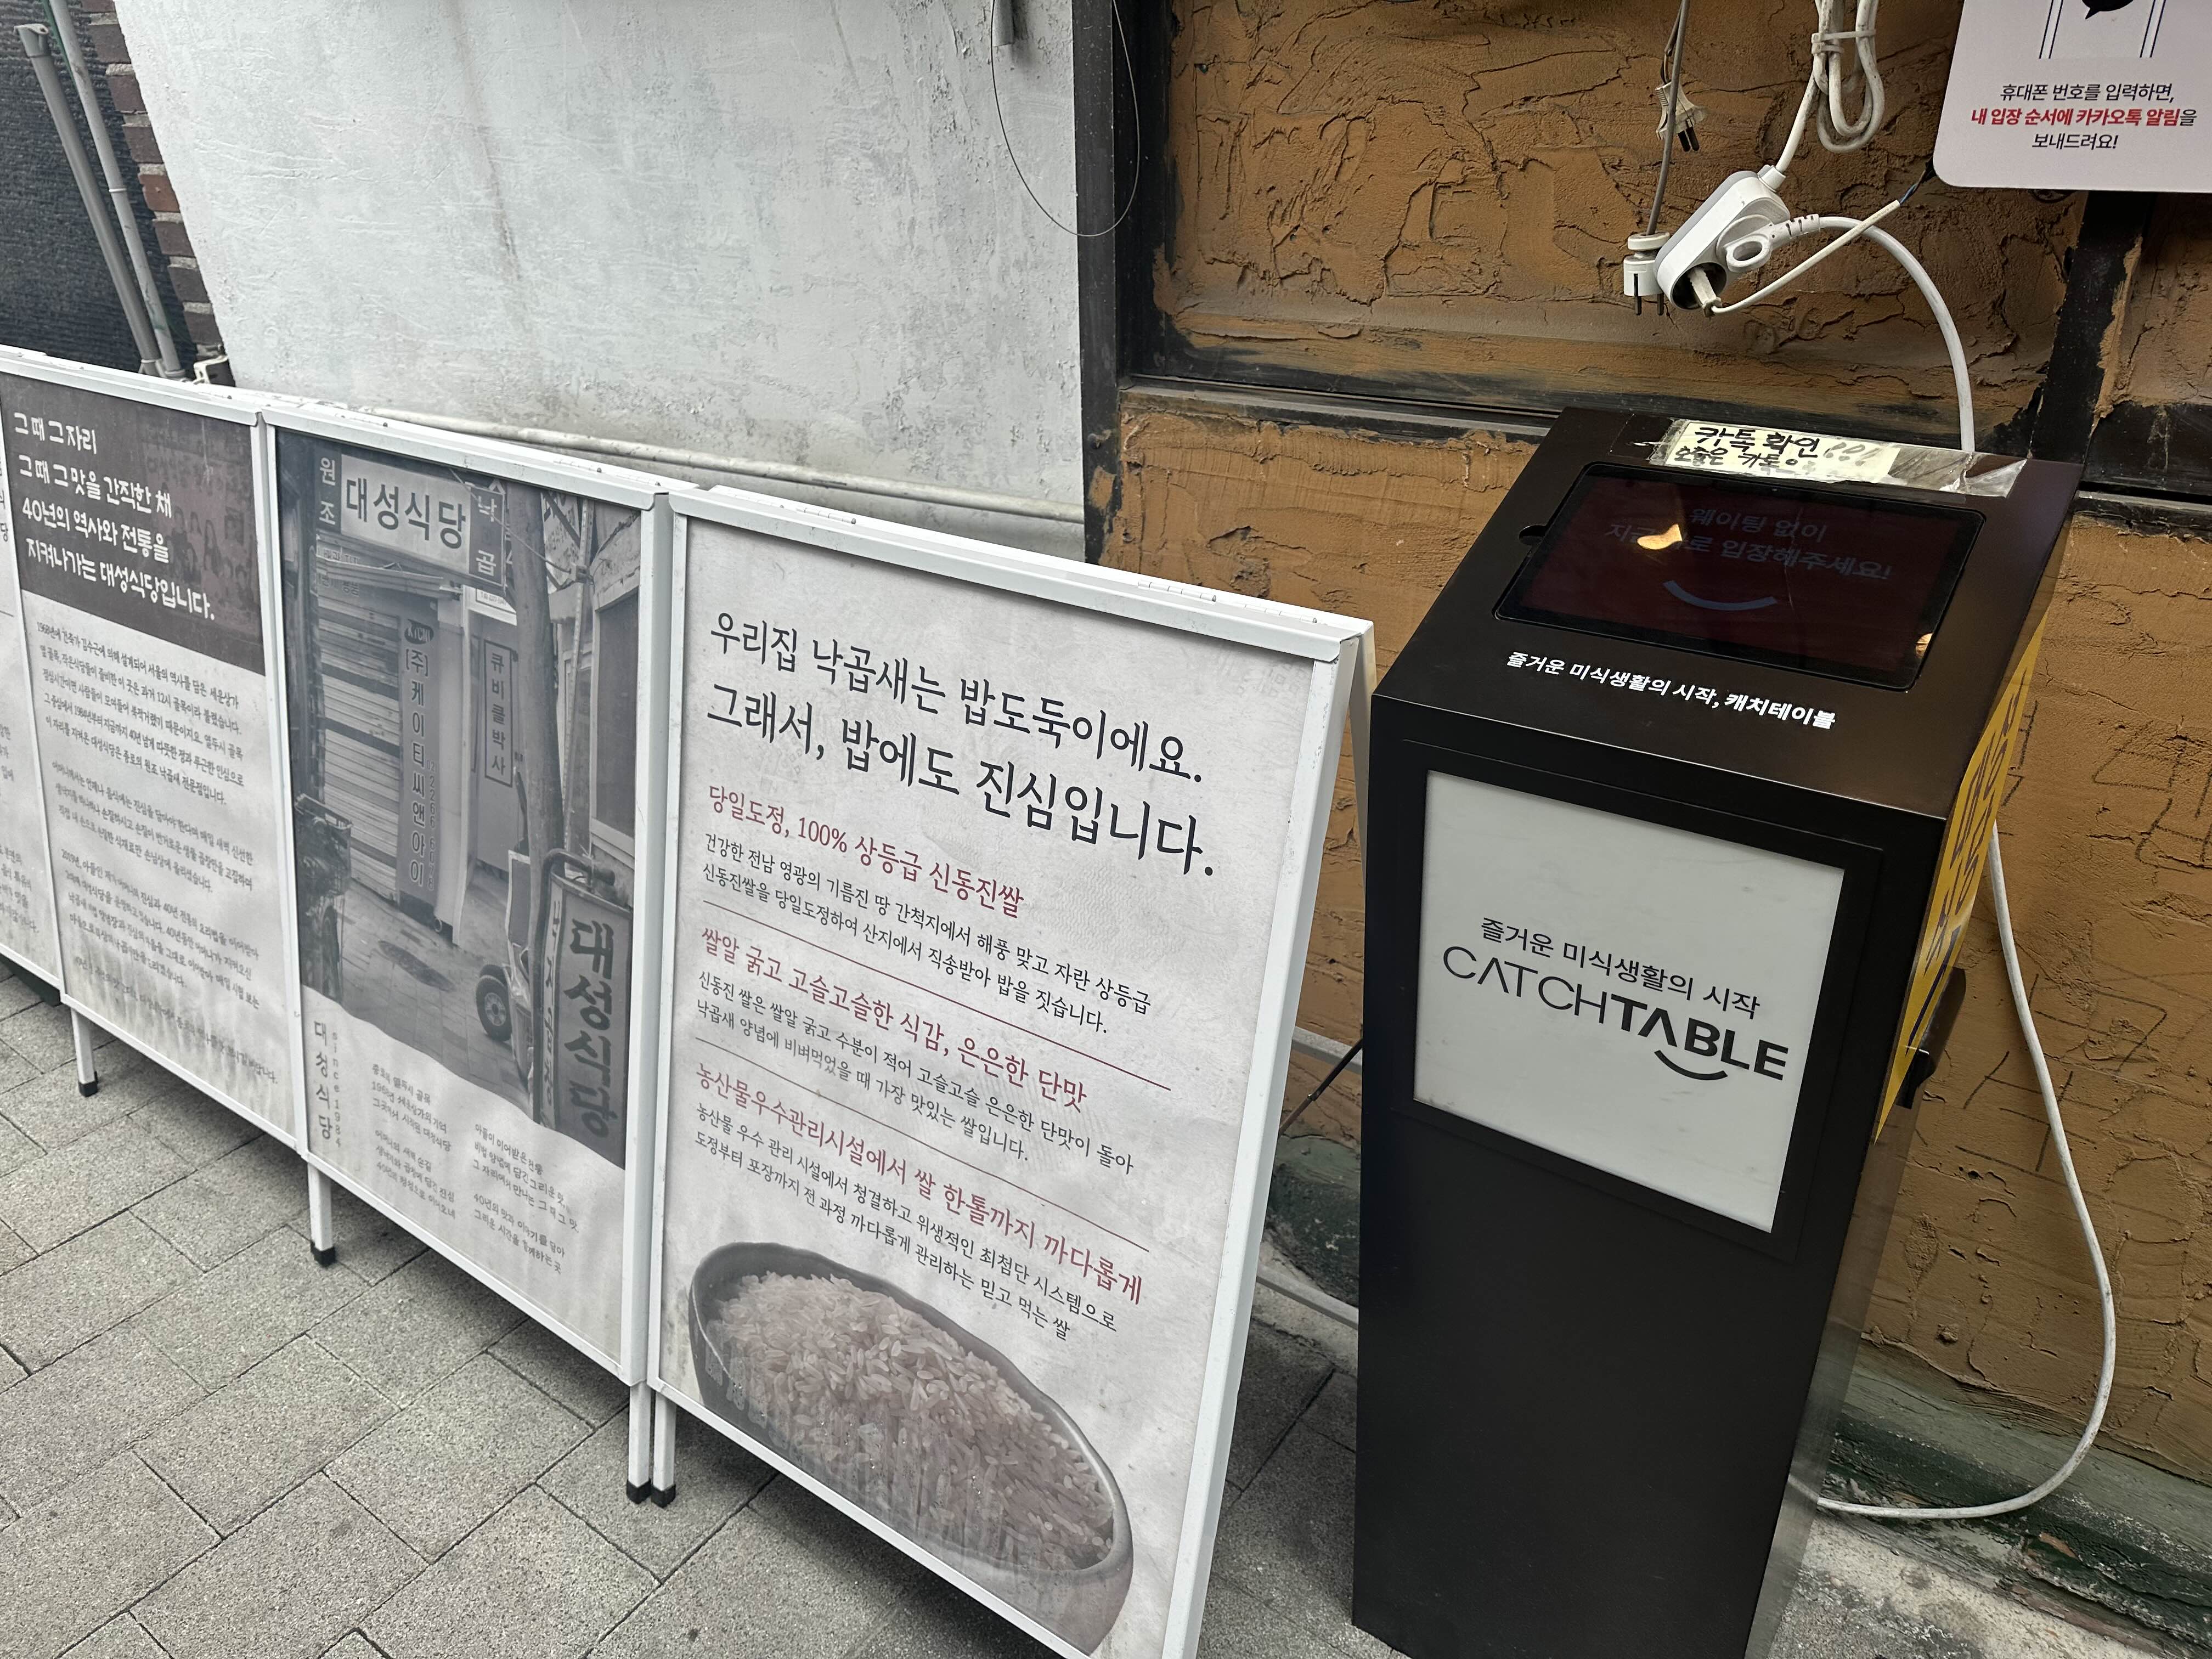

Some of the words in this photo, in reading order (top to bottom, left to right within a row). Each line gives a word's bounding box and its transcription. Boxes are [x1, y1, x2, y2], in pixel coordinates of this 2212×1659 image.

[1971, 108, 1988, 125] 내
[1991, 108, 2022, 126] 입장
[2024, 109, 2073, 126] 순서에
[2075, 109, 2142, 126] 카카오톡
[2146, 109, 2197, 127] 알림을
[2000, 83, 2049, 101] 휴대폰
[2052, 84, 2101, 101] 번호를
[2106, 83, 2175, 104] 입력하면,
[2032, 133, 2119, 151] 보내드려요!
[1695, 427, 1756, 451] 카톡
[22, 498, 69, 531] 40년의
[74, 510, 117, 545] 역사와
[121, 524, 168, 562] 전통을
[104, 477, 151, 513] 간직한
[155, 490, 171, 517] 채
[319, 456, 336, 525] 원조
[346, 478, 466, 549] 대성식당
[1690, 508, 1766, 533] 웨이팅
[1774, 519, 1827, 543] 없이
[26, 538, 96, 581] 지켜나가는
[100, 562, 214, 620] 대성식당입니다.
[1720, 539, 1893, 581] 입장해주세요!
[711, 613, 797, 672] 우리집
[813, 639, 945, 714] 낙곱새는
[961, 679, 1201, 782] 밥도둑이에요.
[1507, 652, 1564, 674] 즐거운
[1570, 664, 1671, 695] 미식생활의
[1672, 685, 1718, 708] 시작,
[1724, 694, 1835, 729] 캐치테이블
[707, 684, 823, 760] 그래서,
[842, 719, 959, 794] 밥에도
[976, 760, 1212, 876] 진심입니다.
[709, 786, 788, 837] 당일도정,
[798, 817, 847, 852] 100%
[855, 836, 922, 881] 상등급
[929, 862, 1024, 918] 신동진쌀
[703, 864, 770, 902] 신동진쌀을
[776, 890, 856, 936] 당일도정하여
[863, 924, 921, 961] 산지에서
[928, 948, 990, 987] 직송받아
[998, 974, 1029, 1003] 밥을
[1036, 990, 1106, 1032] 짓습니다.
[706, 834, 743, 862] 건강한
[748, 850, 775, 873] 전남
[780, 861, 820, 890] 영광의
[827, 879, 867, 909] 기름진
[875, 895, 890, 915] 땅
[896, 902, 970, 946] 간척지에서
[977, 934, 1009, 960] 해풍
[1017, 946, 1048, 974] 맞고
[1054, 963, 1090, 991] 자란
[1096, 977, 1150, 1014] 상등급
[1481, 917, 1553, 957] 즐거운
[1564, 943, 1692, 1000] 미식생활의
[1703, 986, 1759, 1019] 시작
[564, 917, 618, 1138] 대성식당
[702, 928, 739, 964] 쌀알
[746, 946, 781, 981] 굵고
[788, 968, 893, 1030] 고슬고슬한
[900, 1013, 948, 1056] 식감,
[958, 1037, 1028, 1087] 은은한
[1039, 1069, 1086, 1113] 단맛
[1443, 946, 1788, 1080] CATCHTABLE
[314, 1020, 332, 1140] 대성식당
[698, 1000, 733, 1029] 낙곱새
[740, 1019, 778, 1048] 양념에
[785, 1039, 851, 1081] 비벼먹었을
[857, 1071, 870, 1090] 때
[876, 1080, 905, 1104] 가장
[911, 1093, 955, 1128] 맛있는
[961, 1116, 1027, 1160] 쌀입니다.
[699, 971, 733, 1001] 신동진
[738, 989, 765, 1014] 쌀은
[770, 1003, 797, 1028] 쌀알
[803, 1016, 831, 1041] 굵고
[836, 1032, 876, 1063] 수분이
[883, 1052, 910, 1077] 적어
[917, 1068, 979, 1107] 고슬고슬
[985, 1097, 1034, 1132] 은은한
[1041, 1120, 1090, 1156] 단맛이
[1097, 1144, 1133, 1174] 돌아
[530, 1179, 555, 1198] 그리운
[538, 1200, 546, 1210] 그
[558, 1214, 566, 1224] 그
[696, 1063, 905, 1184] 농산물우수관리시설에서
[915, 1169, 935, 1200] 쌀
[944, 1183, 1034, 1249] 한톨까지
[1045, 1234, 1141, 1305] 까다롭게
[697, 1103, 732, 1135] 농산물
[737, 1125, 763, 1147] 우수
[768, 1139, 792, 1164] 관리
[797, 1156, 847, 1194] 시설에서
[853, 1183, 911, 1223] 청결하고
[917, 1215, 973, 1259] 위생적인
[980, 1248, 1029, 1284] 최첨단
[1034, 1277, 1116, 1331] 시스템으로
[695, 1131, 742, 1167] 도정부터
[747, 1159, 798, 1195] 포장까지
[804, 1187, 814, 1206] 전
[820, 1197, 845, 1223] 과정
[851, 1214, 910, 1254] 까다롭게
[915, 1244, 974, 1289] 관리하는
[981, 1278, 1011, 1306] 믿고
[1019, 1296, 1047, 1328] 먹는
[1053, 1318, 1070, 1340] 쌀
